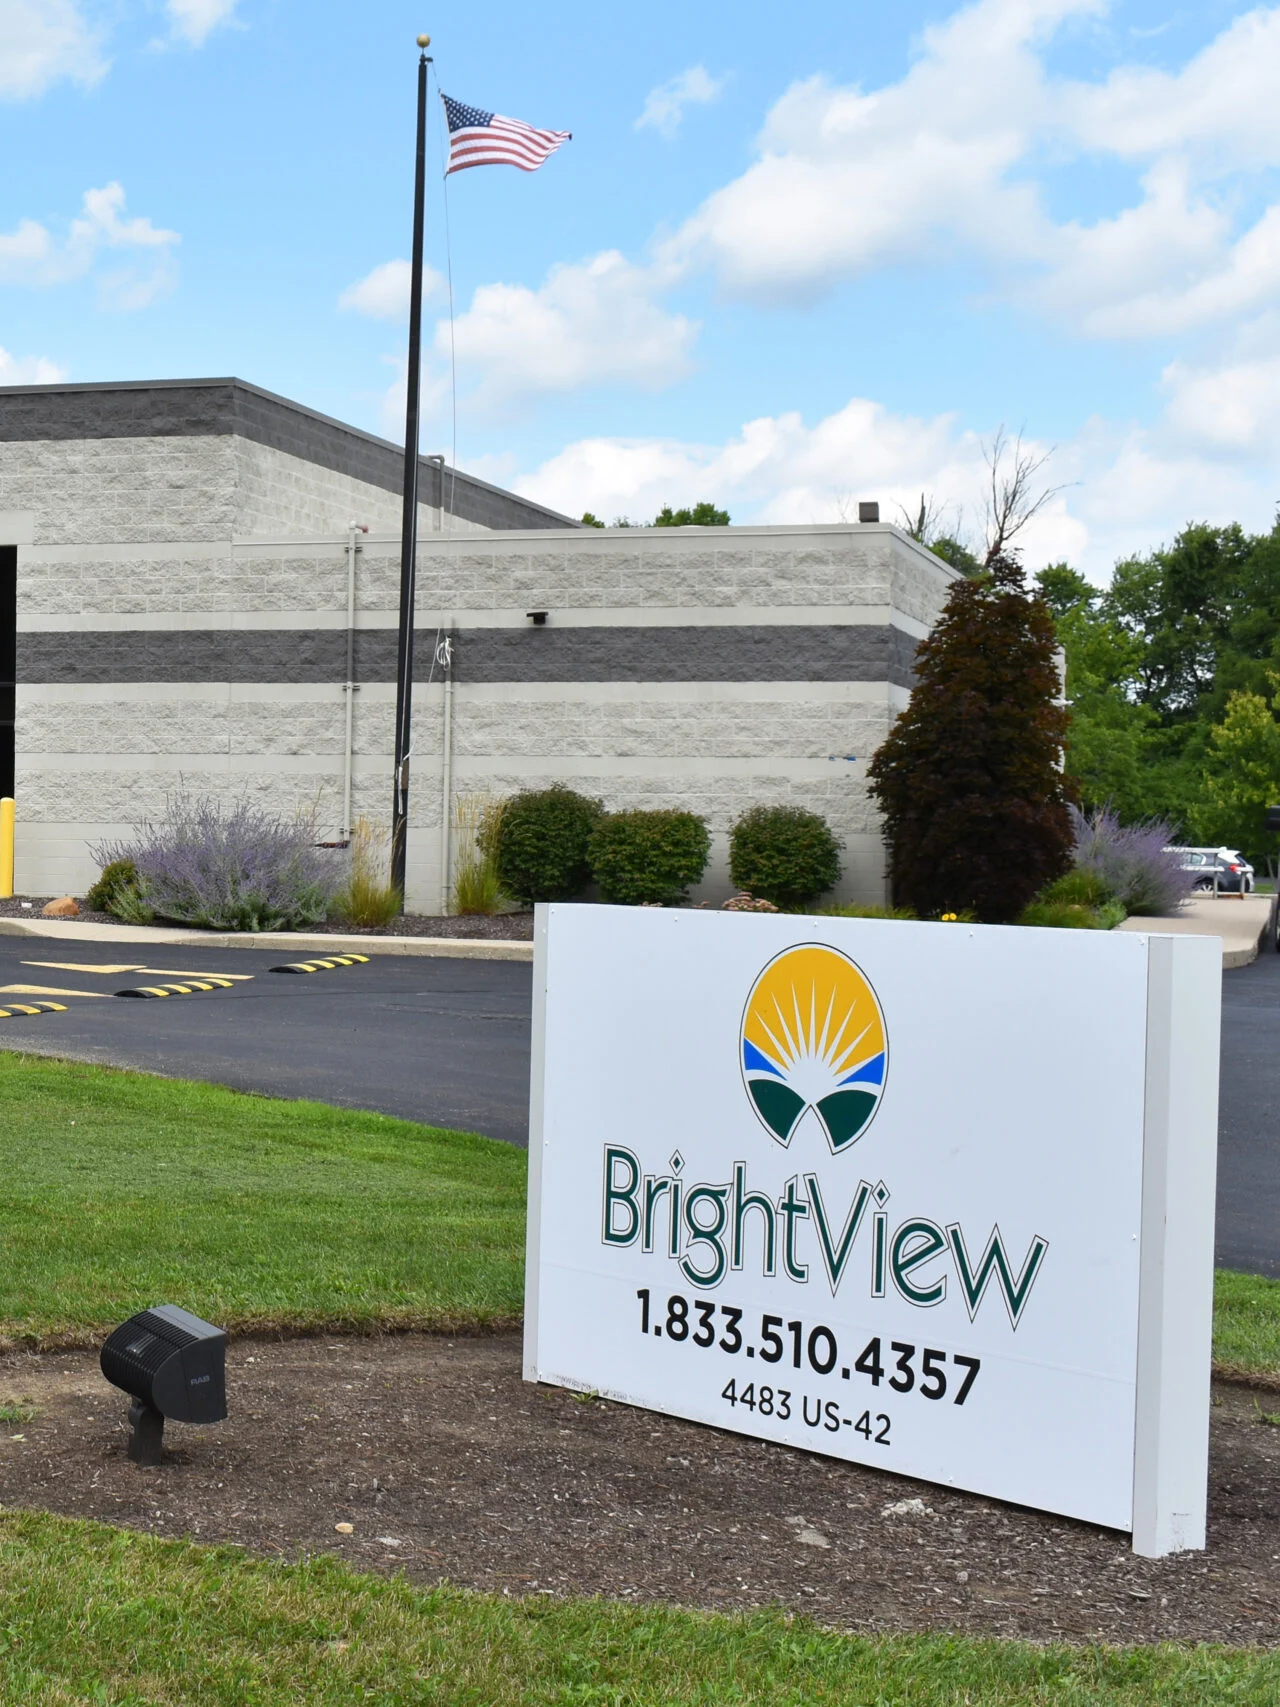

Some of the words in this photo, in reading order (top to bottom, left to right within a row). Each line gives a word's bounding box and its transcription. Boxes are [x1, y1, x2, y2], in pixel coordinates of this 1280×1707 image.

[601, 1143, 1049, 1332] BrightView
[636, 1288, 981, 1406] 1.833.510.4357
[721, 1378, 791, 1420] 4483
[803, 1395, 891, 1446] US-42
